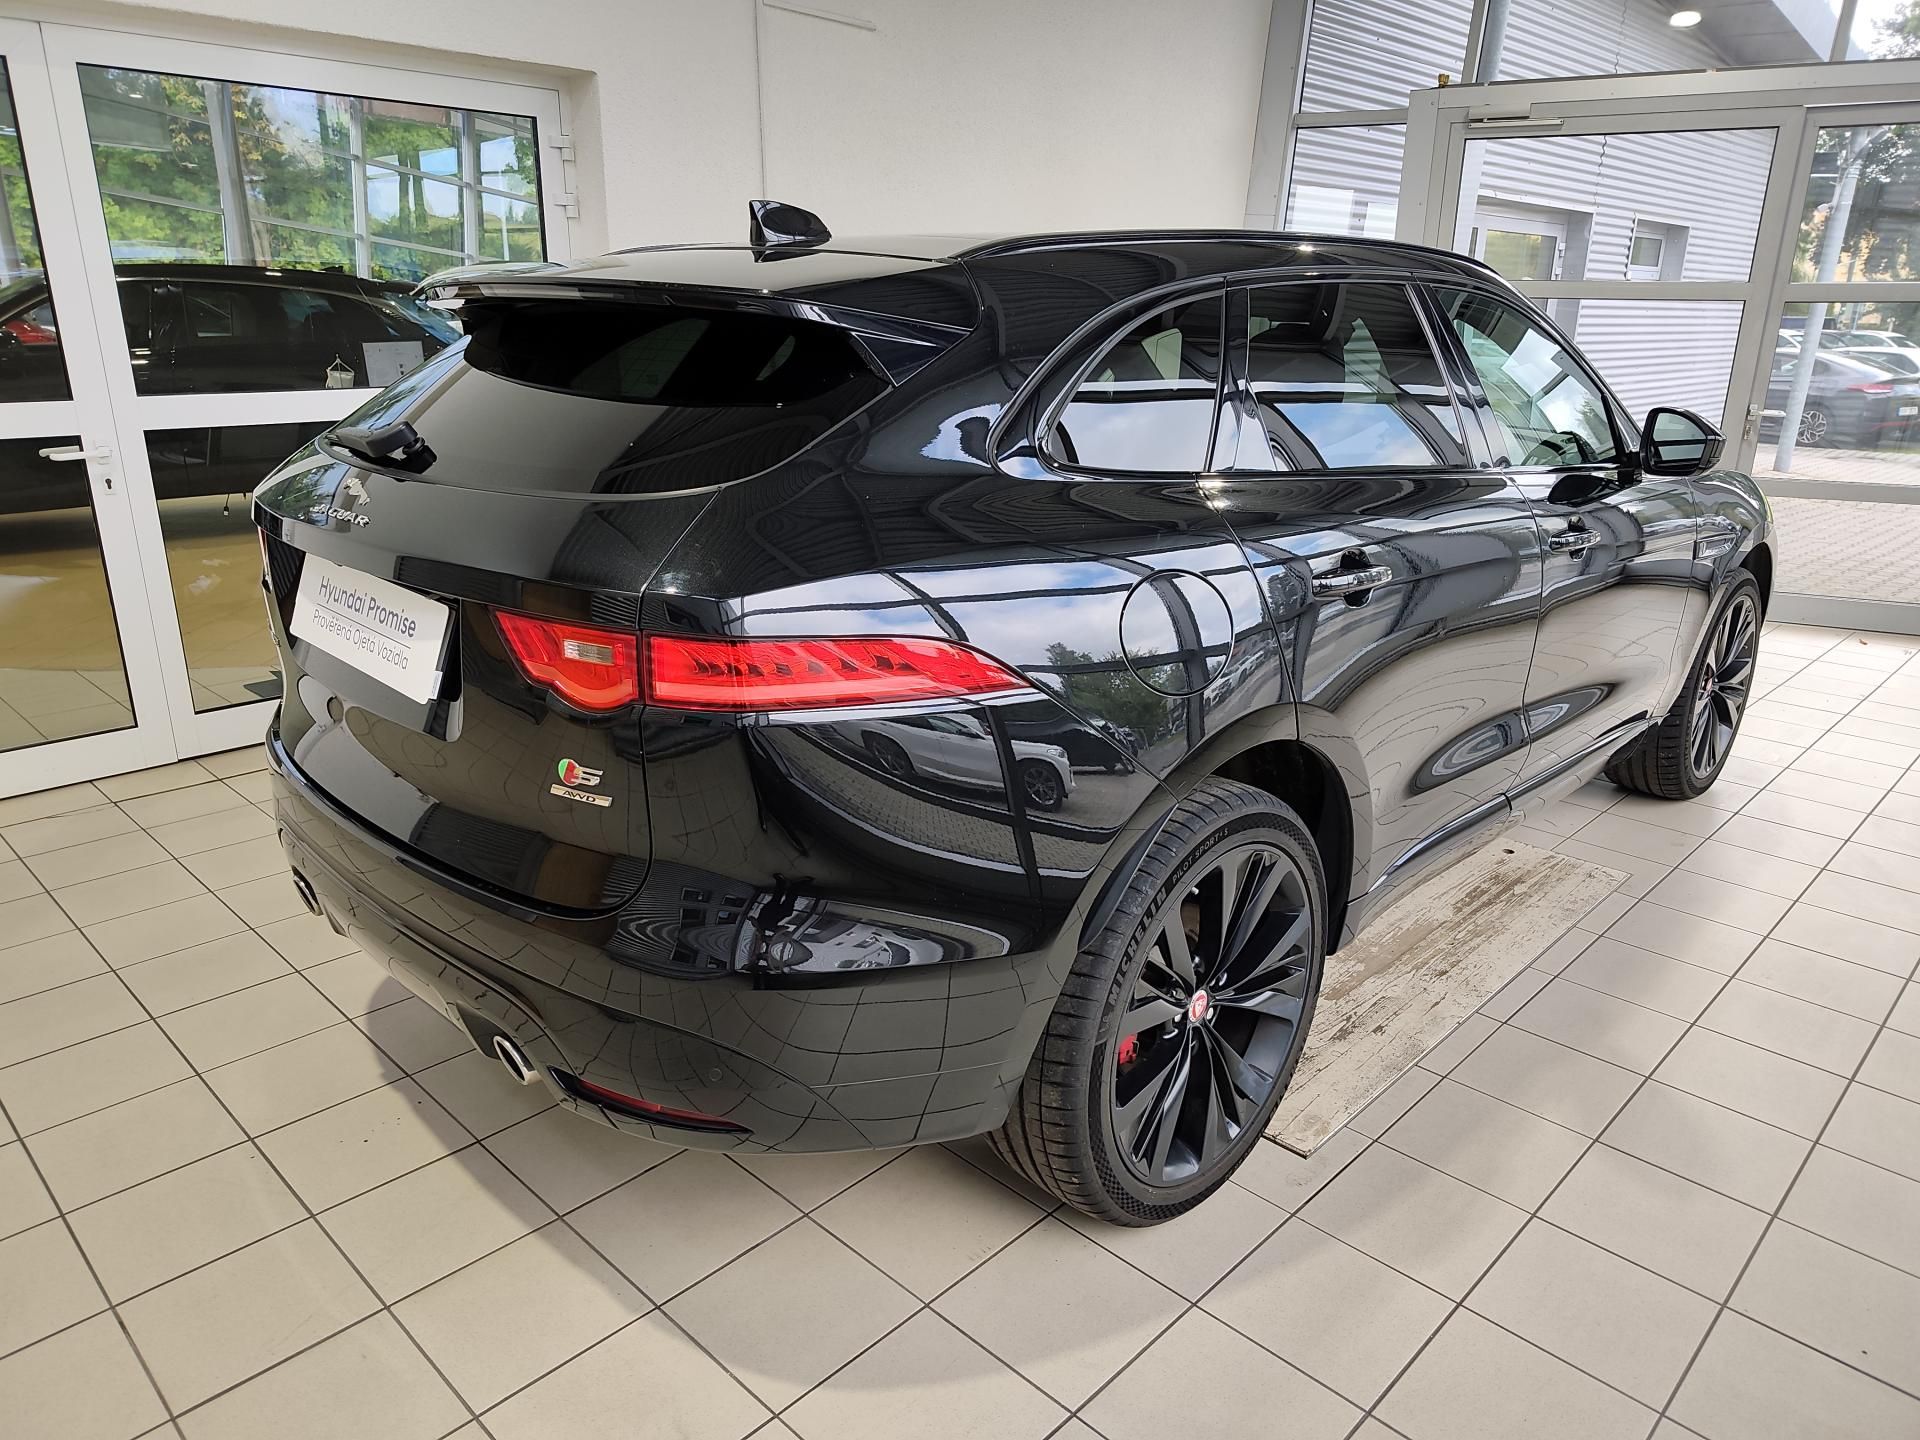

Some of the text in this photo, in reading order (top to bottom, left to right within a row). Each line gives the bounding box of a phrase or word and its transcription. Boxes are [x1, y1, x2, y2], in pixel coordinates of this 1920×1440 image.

[310, 504, 370, 528] JAGUAR
[318, 575, 416, 638] Hyundai Promise
[377, 639, 409, 670] Vozidla
[562, 790, 597, 803] AWD
[1172, 855, 1193, 884] PILOT
[1195, 832, 1220, 859] SPORT
[1108, 886, 1168, 1007] MICHELIN
